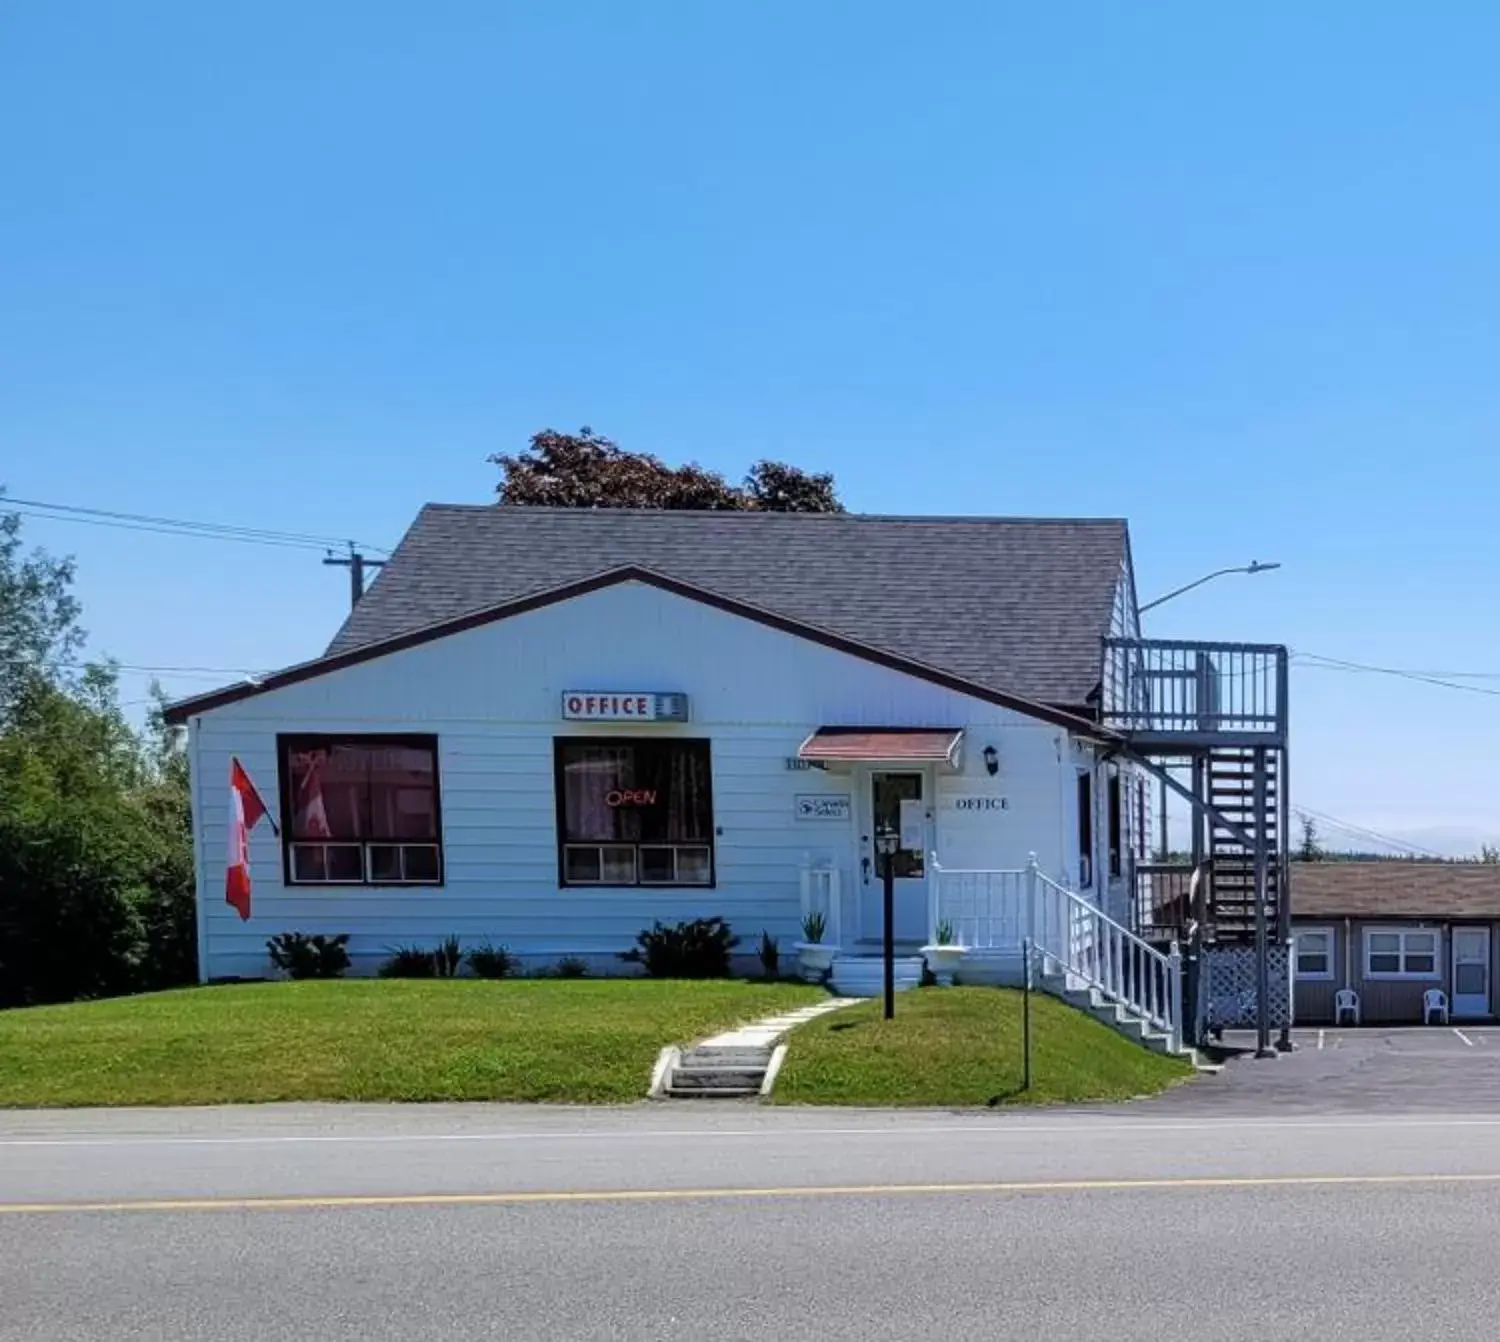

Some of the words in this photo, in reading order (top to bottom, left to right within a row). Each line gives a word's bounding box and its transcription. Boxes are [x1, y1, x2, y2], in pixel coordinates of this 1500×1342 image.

[568, 697, 647, 714] OFFICE
[606, 790, 656, 806] OPEN
[956, 798, 1009, 810] OFFICE
